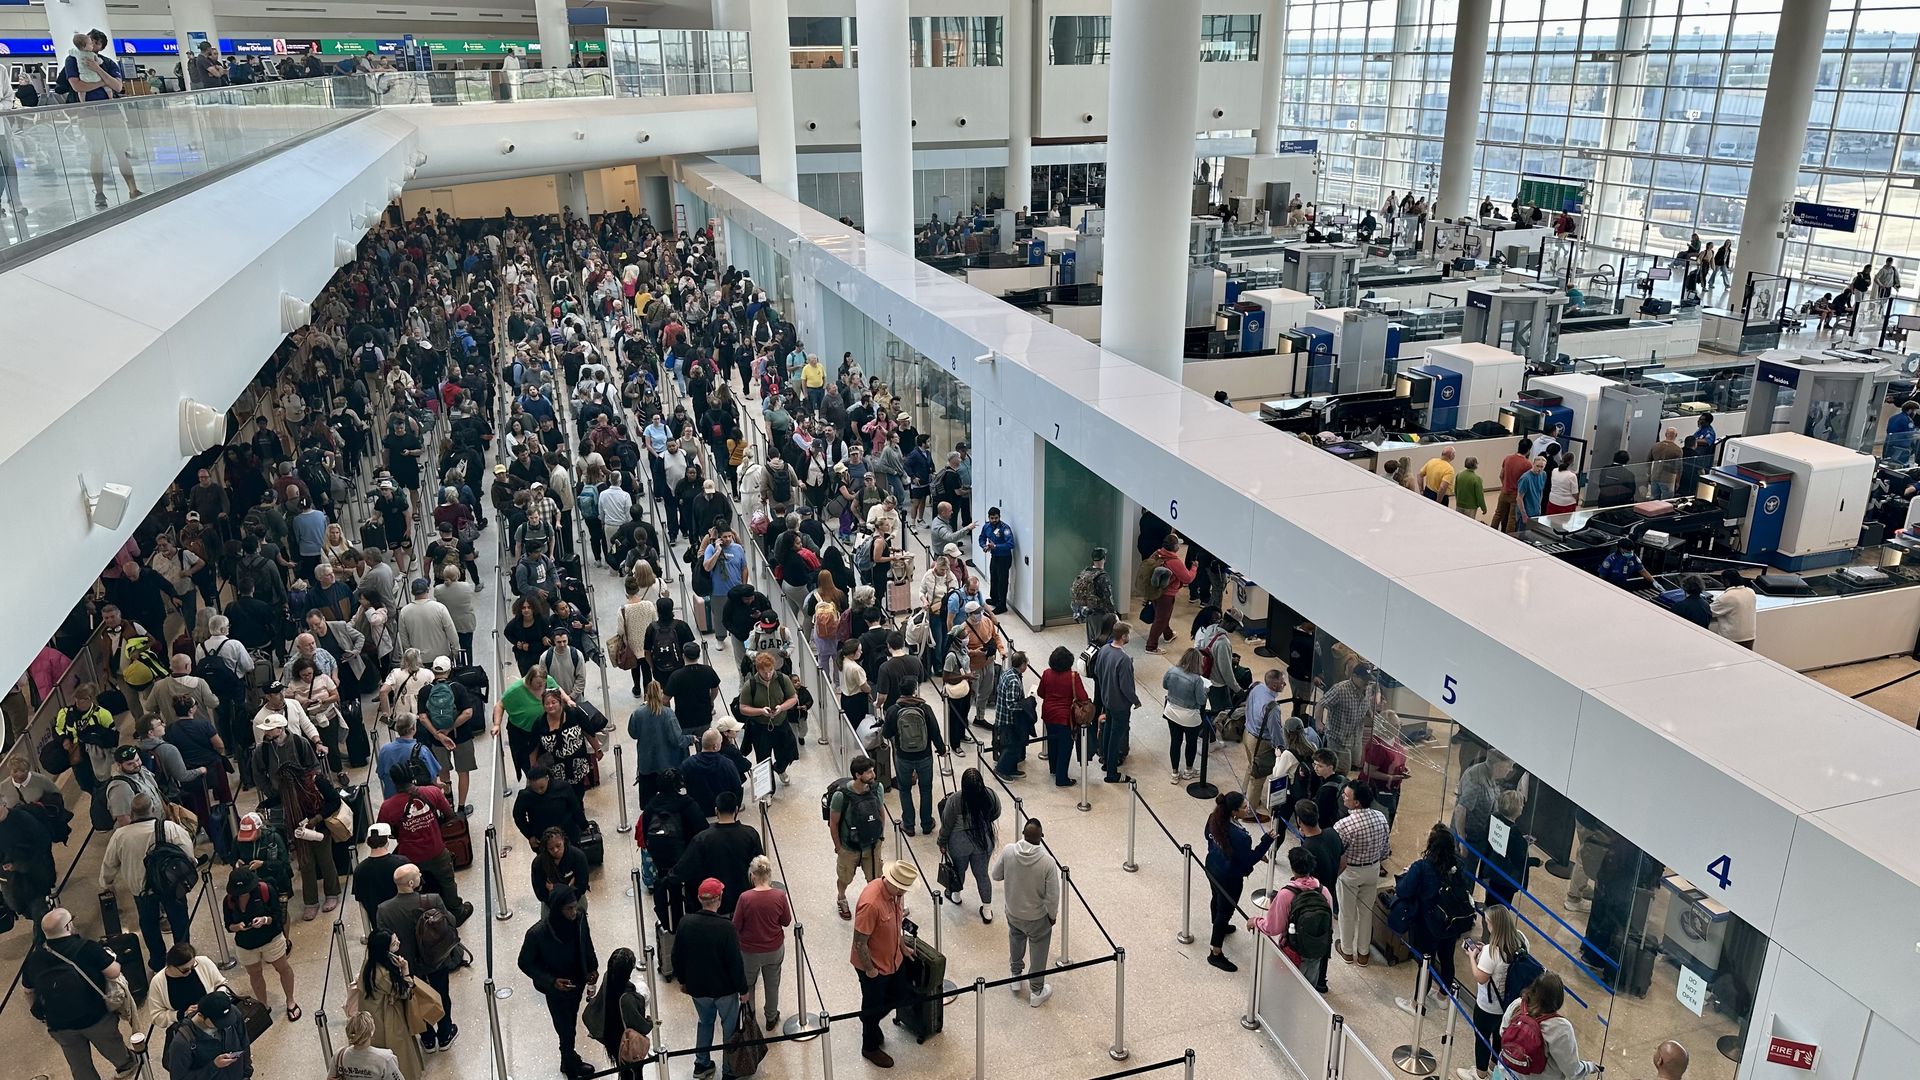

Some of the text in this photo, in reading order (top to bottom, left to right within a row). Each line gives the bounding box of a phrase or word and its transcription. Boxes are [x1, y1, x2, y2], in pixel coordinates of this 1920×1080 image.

[888, 314, 891, 326] 9
[952, 356, 956, 370] 8
[1055, 423, 1059, 440] 7
[1170, 499, 1178, 520] 6
[760, 639, 782, 650] GAP
[1442, 674, 1457, 704] 5
[1494, 830, 1502, 839] NOT
[1492, 837, 1502, 848] OPEN
[1706, 854, 1732, 890] 4
[1689, 976, 1697, 985] DO
[1686, 984, 1696, 995] NOT
[1682, 992, 1696, 1006] OPEN
[1771, 1044, 1793, 1056] FIRE
